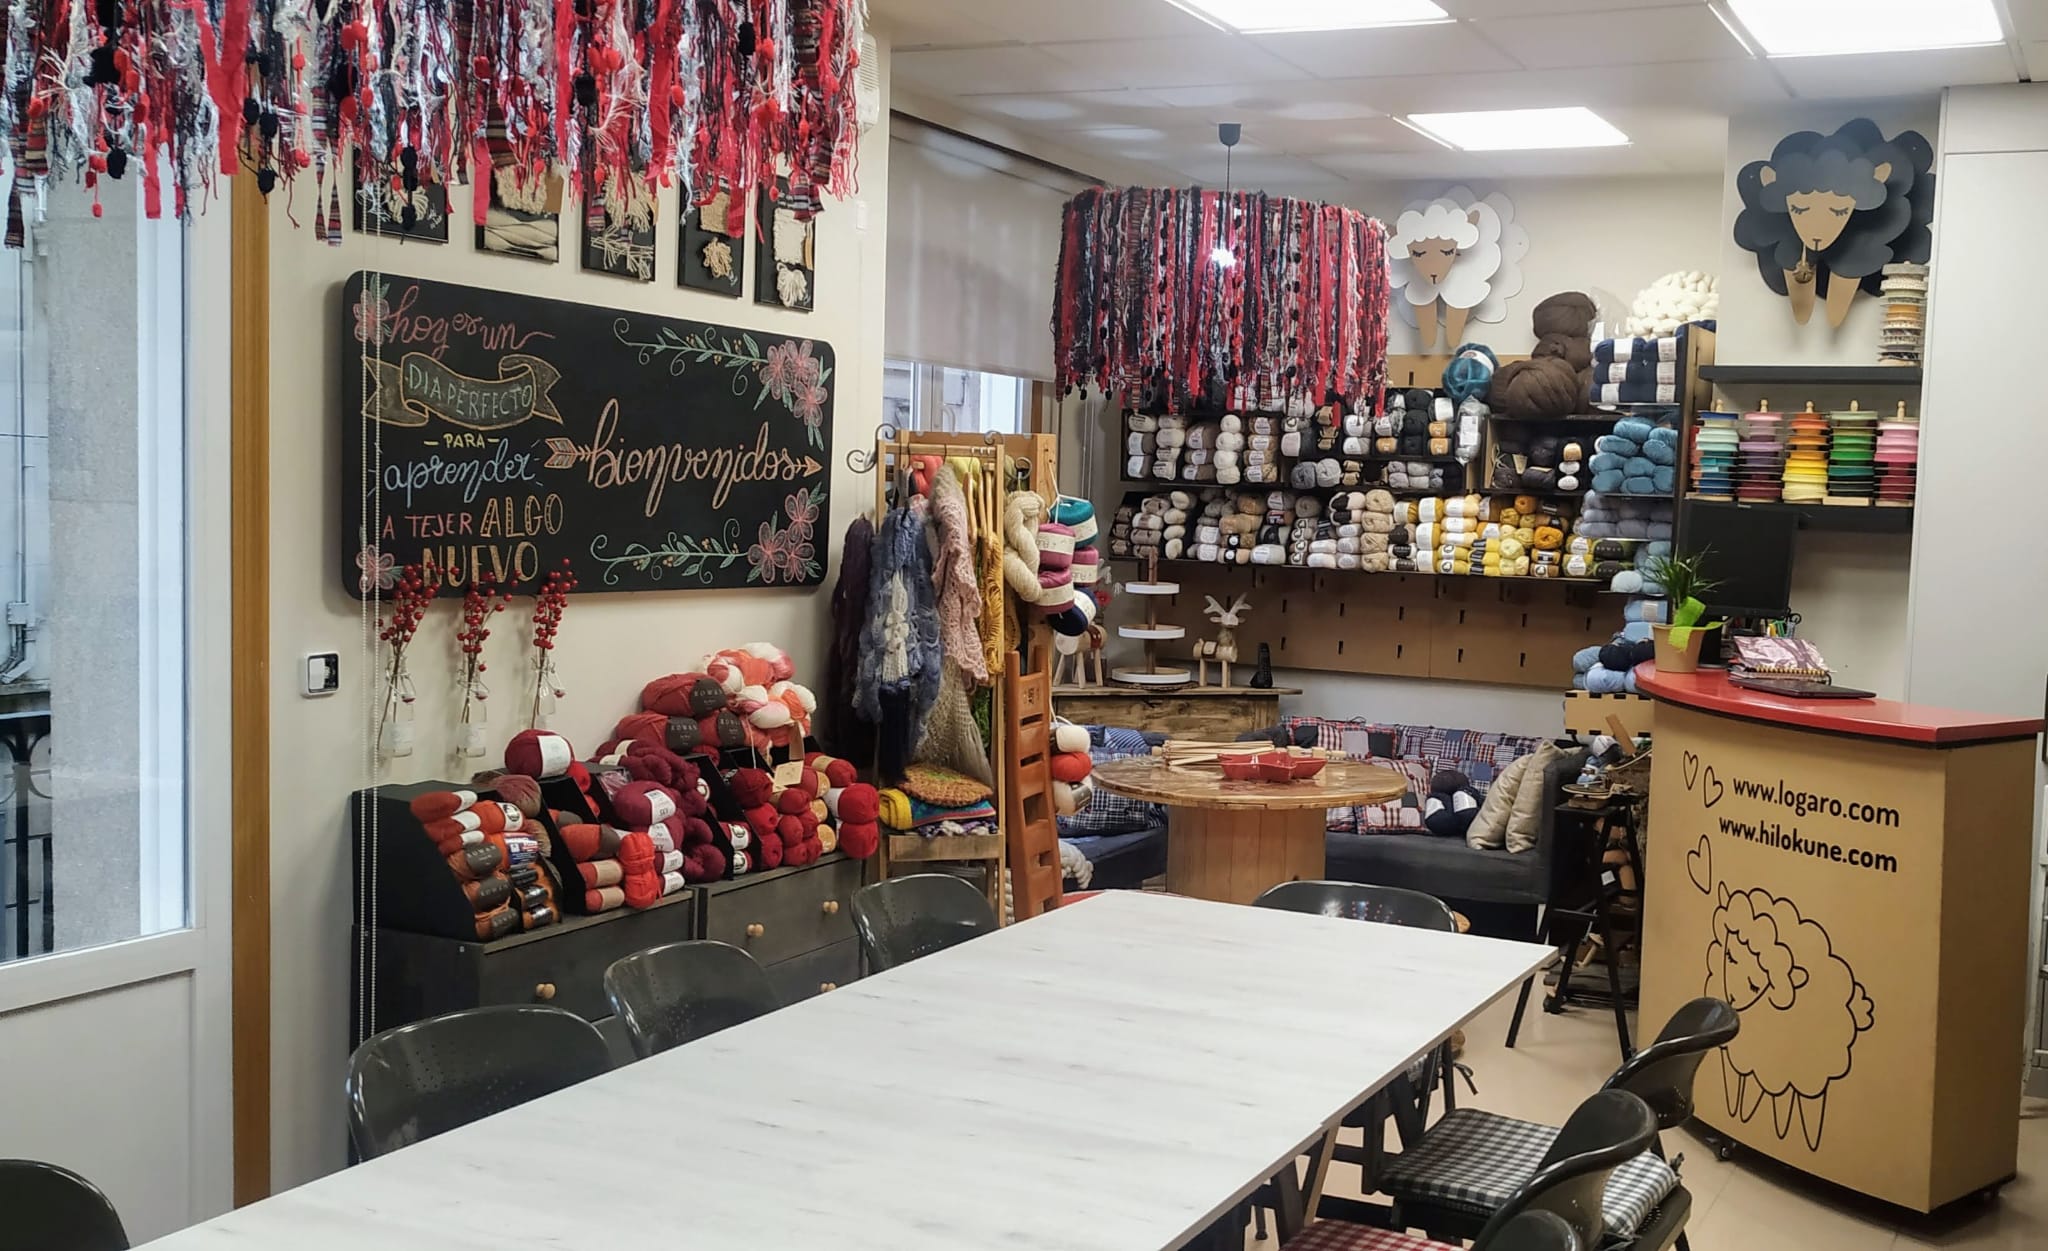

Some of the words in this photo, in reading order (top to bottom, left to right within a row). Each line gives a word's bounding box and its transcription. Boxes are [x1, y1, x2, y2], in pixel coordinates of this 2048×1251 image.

[388, 285, 450, 359] hoy
[480, 321, 556, 350] un
[384, 438, 536, 508] aprender
[588, 398, 795, 517] bienvenidos
[383, 517, 395, 541] A
[404, 513, 473, 538] TEJER
[480, 493, 564, 538] ALGO
[422, 541, 538, 587] NUEVO
[1733, 777, 1900, 828] www.logaro.com
[1718, 816, 1898, 873] www.hilokune.com
